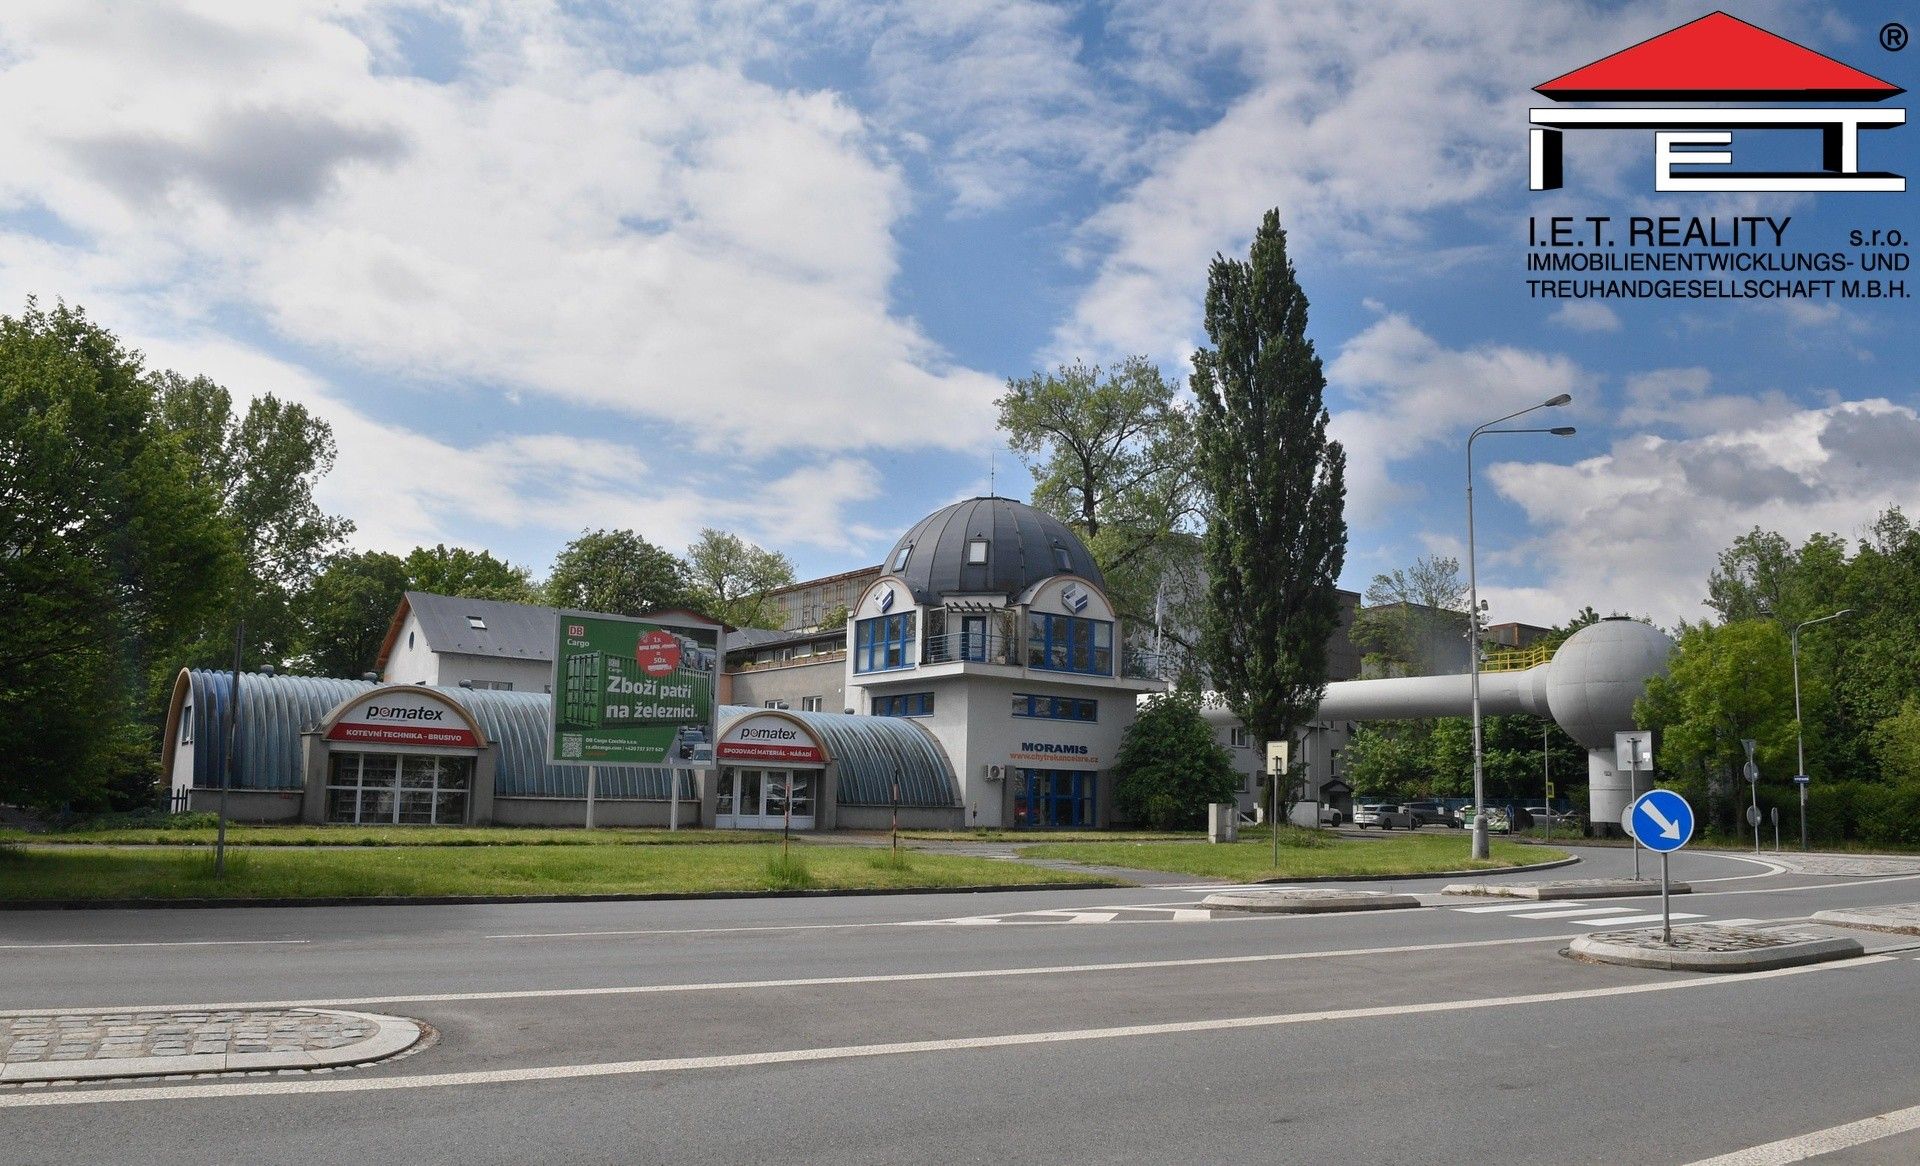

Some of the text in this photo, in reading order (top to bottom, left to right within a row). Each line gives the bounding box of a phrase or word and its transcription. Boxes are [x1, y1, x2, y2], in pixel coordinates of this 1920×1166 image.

[569, 626, 585, 636] DB
[567, 638, 590, 649] Cargo
[607, 675, 692, 700] Zboží patří
[366, 706, 444, 721] pomatex
[606, 701, 698, 718] na železnici.
[346, 729, 382, 737] KOTEVNÍ
[384, 731, 423, 739] TECHNIKA
[740, 728, 797, 740] pomatex
[757, 748, 786, 757] MATERIÁL
[1022, 742, 1087, 754] MORAMIS
[1010, 753, 1098, 763] www.chytrekancelare.cz
